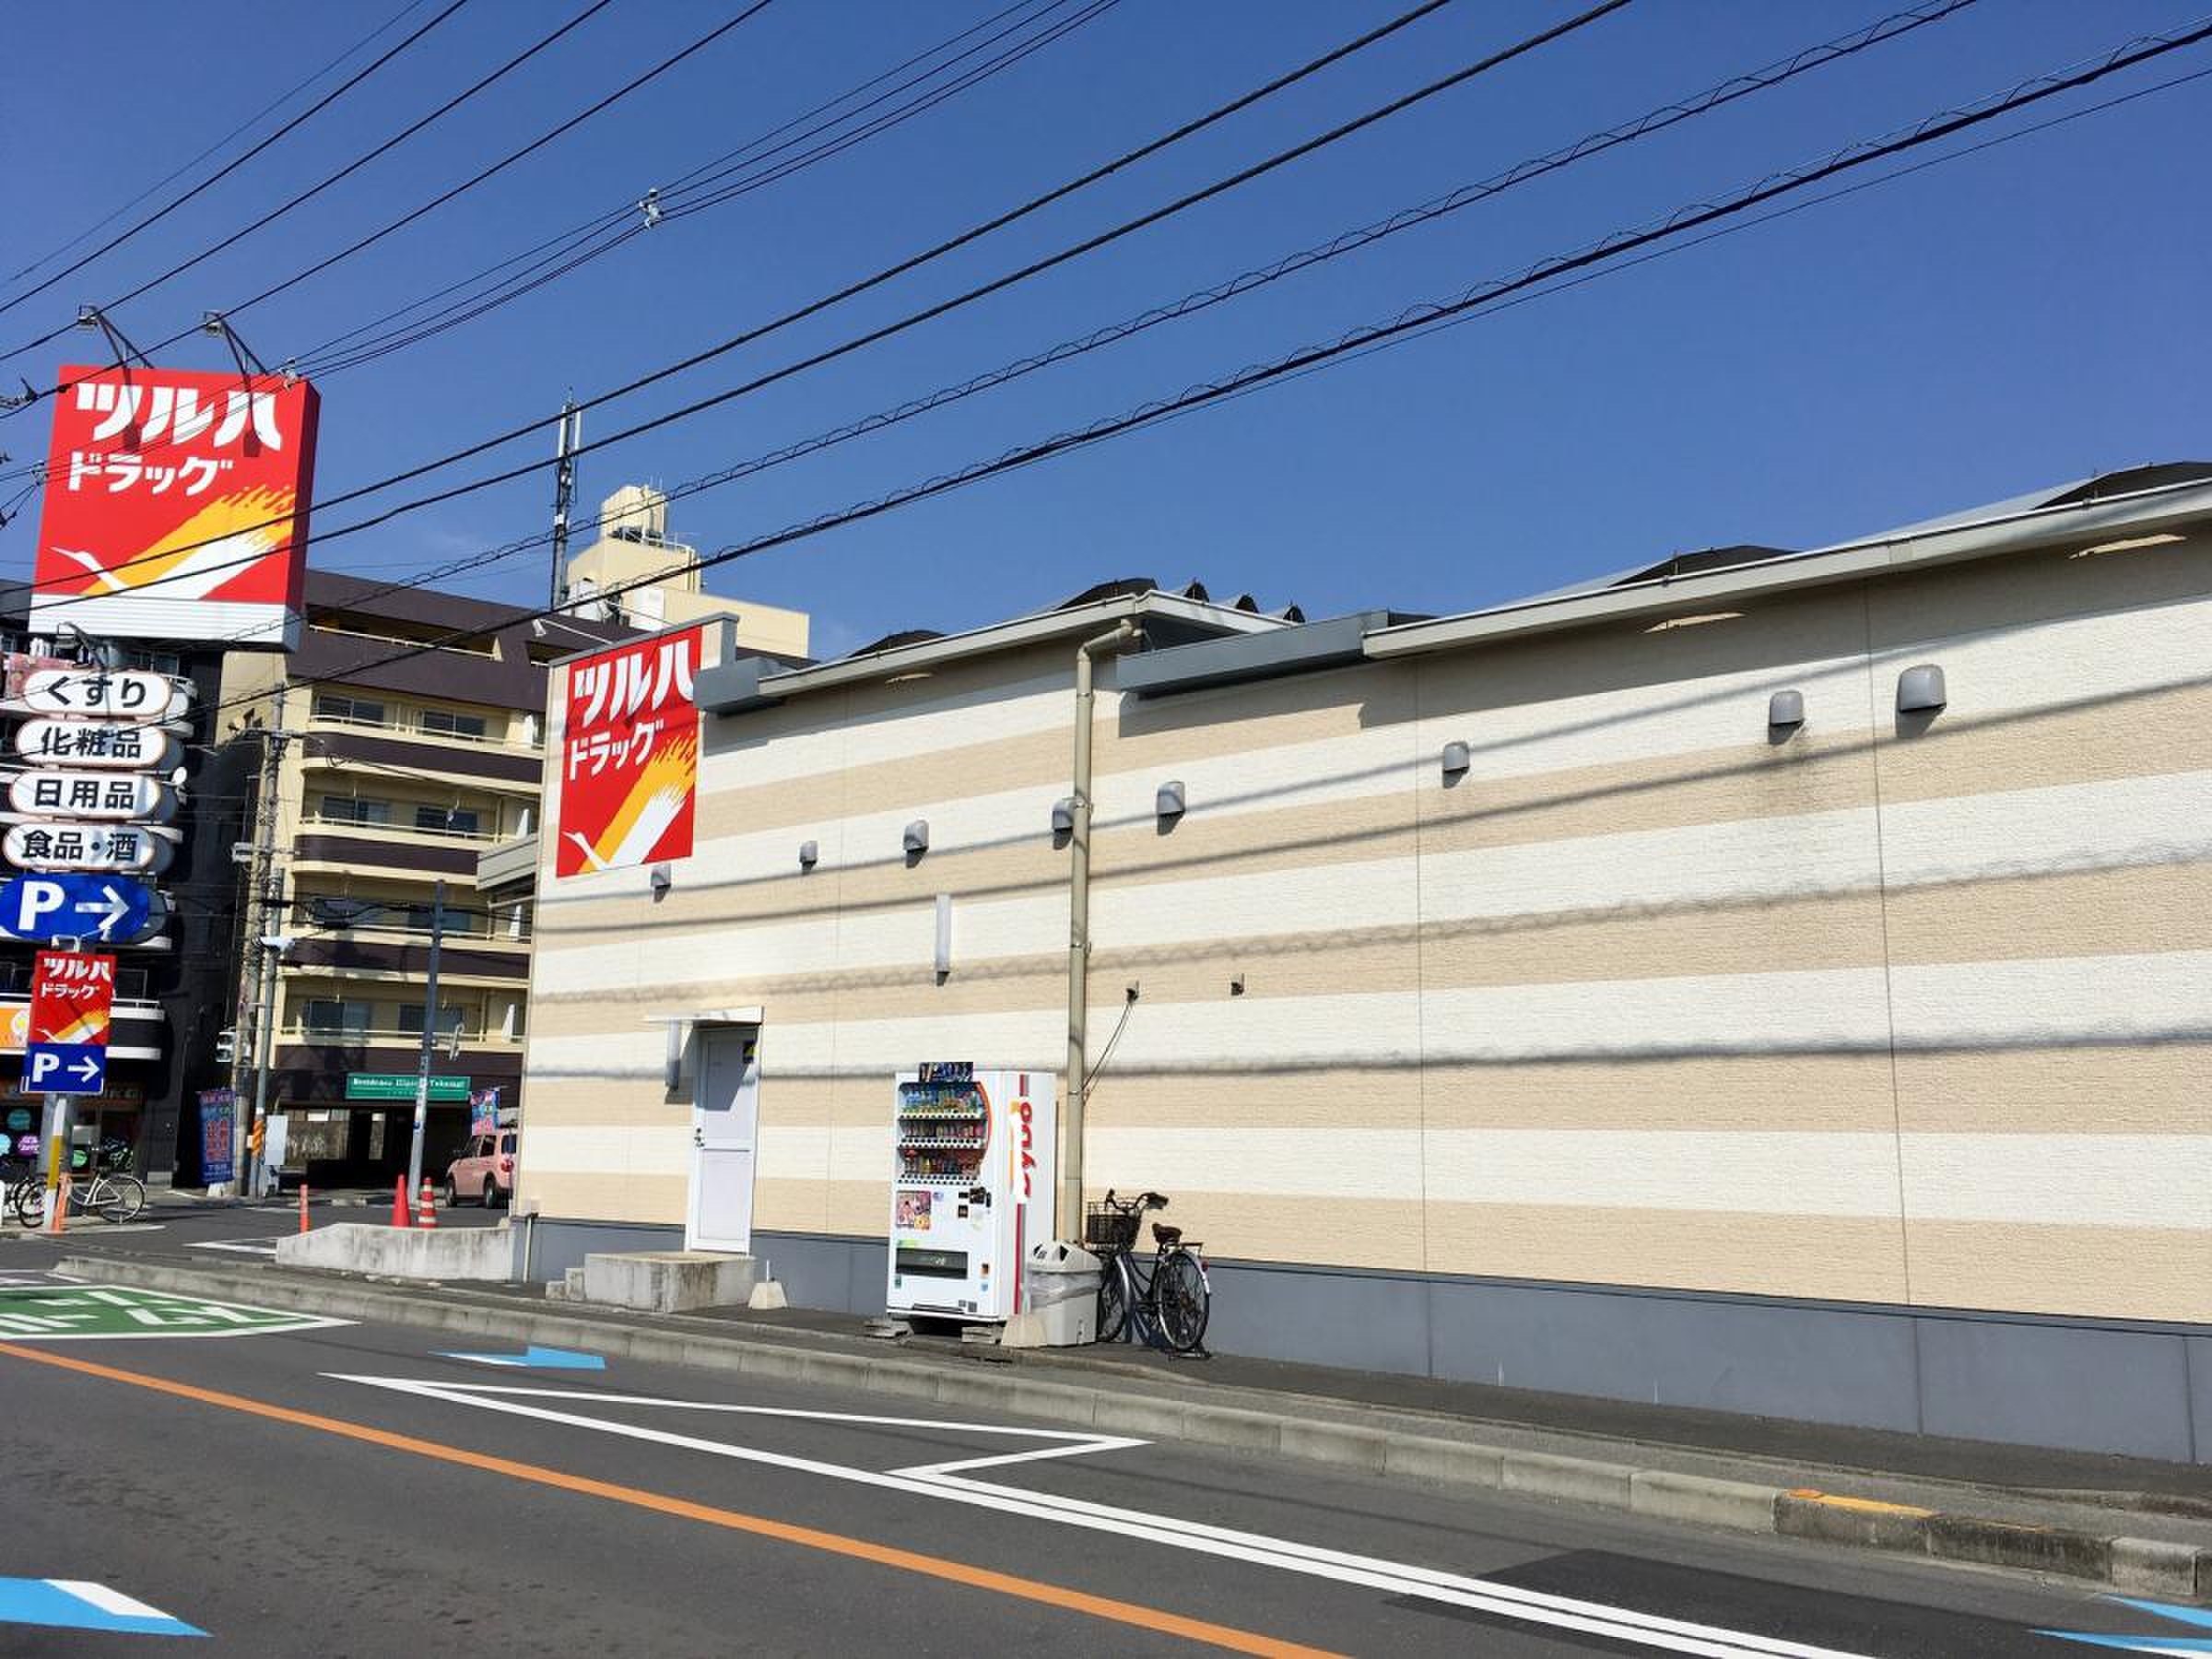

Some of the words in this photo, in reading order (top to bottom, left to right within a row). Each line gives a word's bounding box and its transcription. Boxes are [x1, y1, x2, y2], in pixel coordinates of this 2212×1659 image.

[76, 382, 282, 451] ツルハ
[67, 452, 234, 496] ドラッグ
[47, 676, 147, 708] くすり
[574, 640, 693, 727] ツルハ
[41, 726, 141, 759] 化粧品
[570, 718, 664, 782] ドラッグ
[34, 779, 135, 809] 日用品
[22, 830, 138, 862] 食品・酒
[18, 880, 65, 931] P
[43, 958, 112, 982] ツルハ
[41, 982, 100, 999] ドラッグ
[31, 1053, 60, 1083] P
